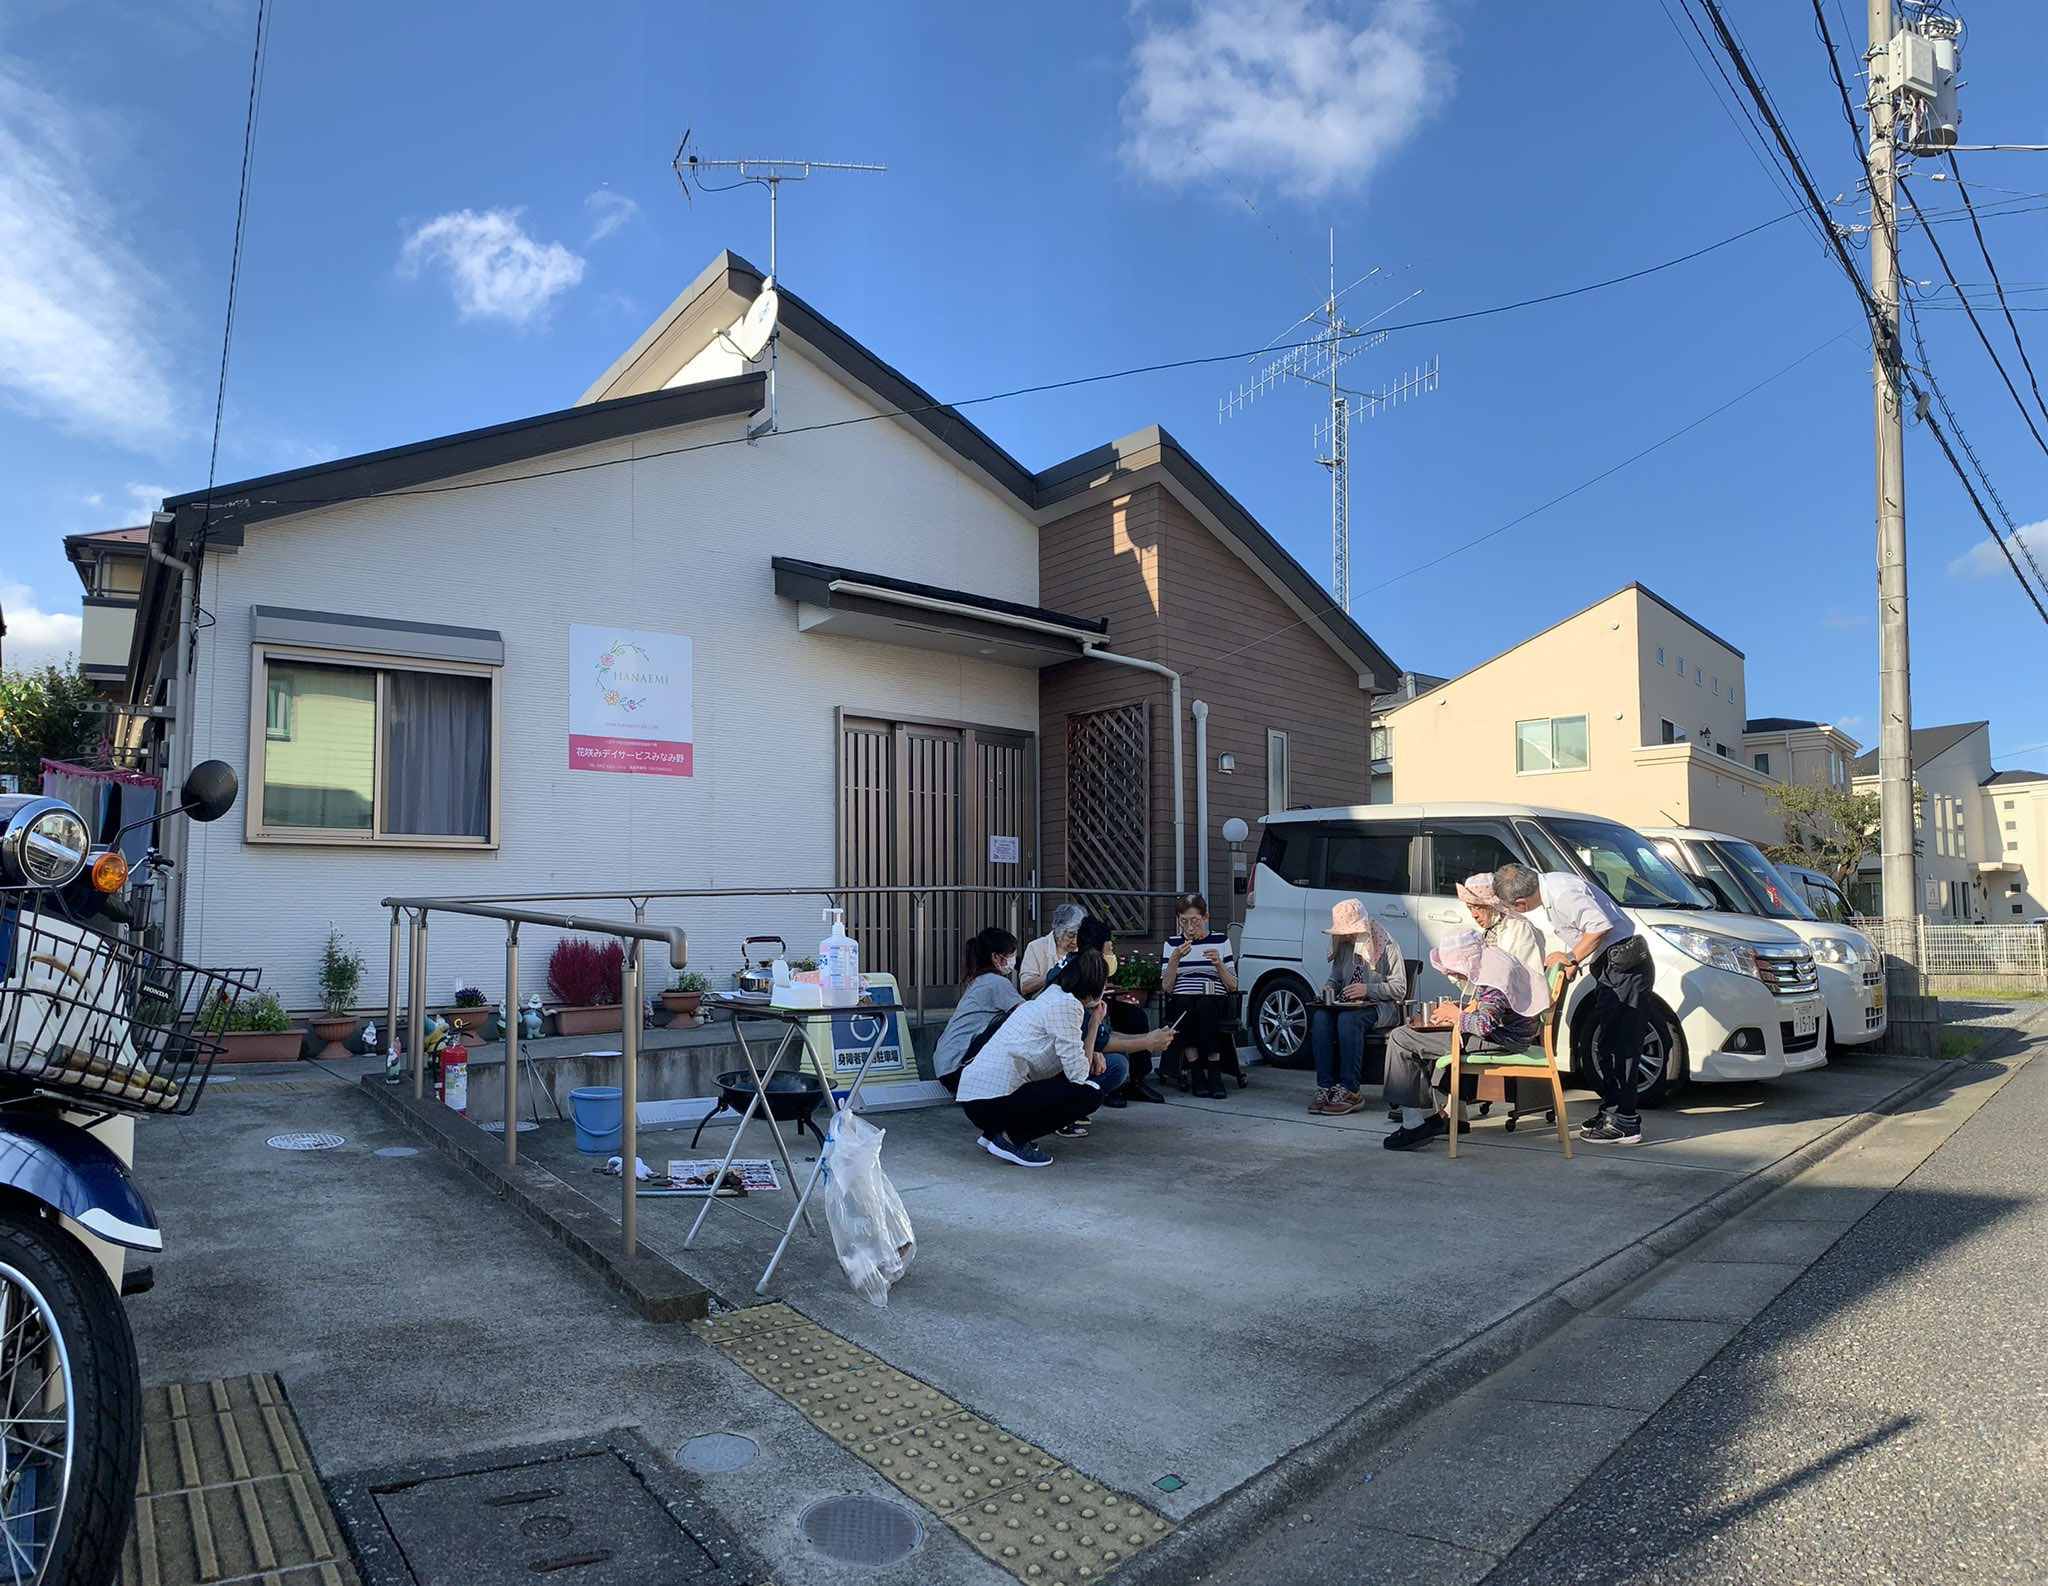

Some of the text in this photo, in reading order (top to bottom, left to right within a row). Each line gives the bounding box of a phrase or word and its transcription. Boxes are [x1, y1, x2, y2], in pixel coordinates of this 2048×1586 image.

[613, 671, 669, 685] HANAEMI
[576, 746, 685, 764] 花咲みデイサービスみなみ野
[143, 985, 169, 999] HONDA
[838, 1050, 899, 1066] 身障者専駐車場
